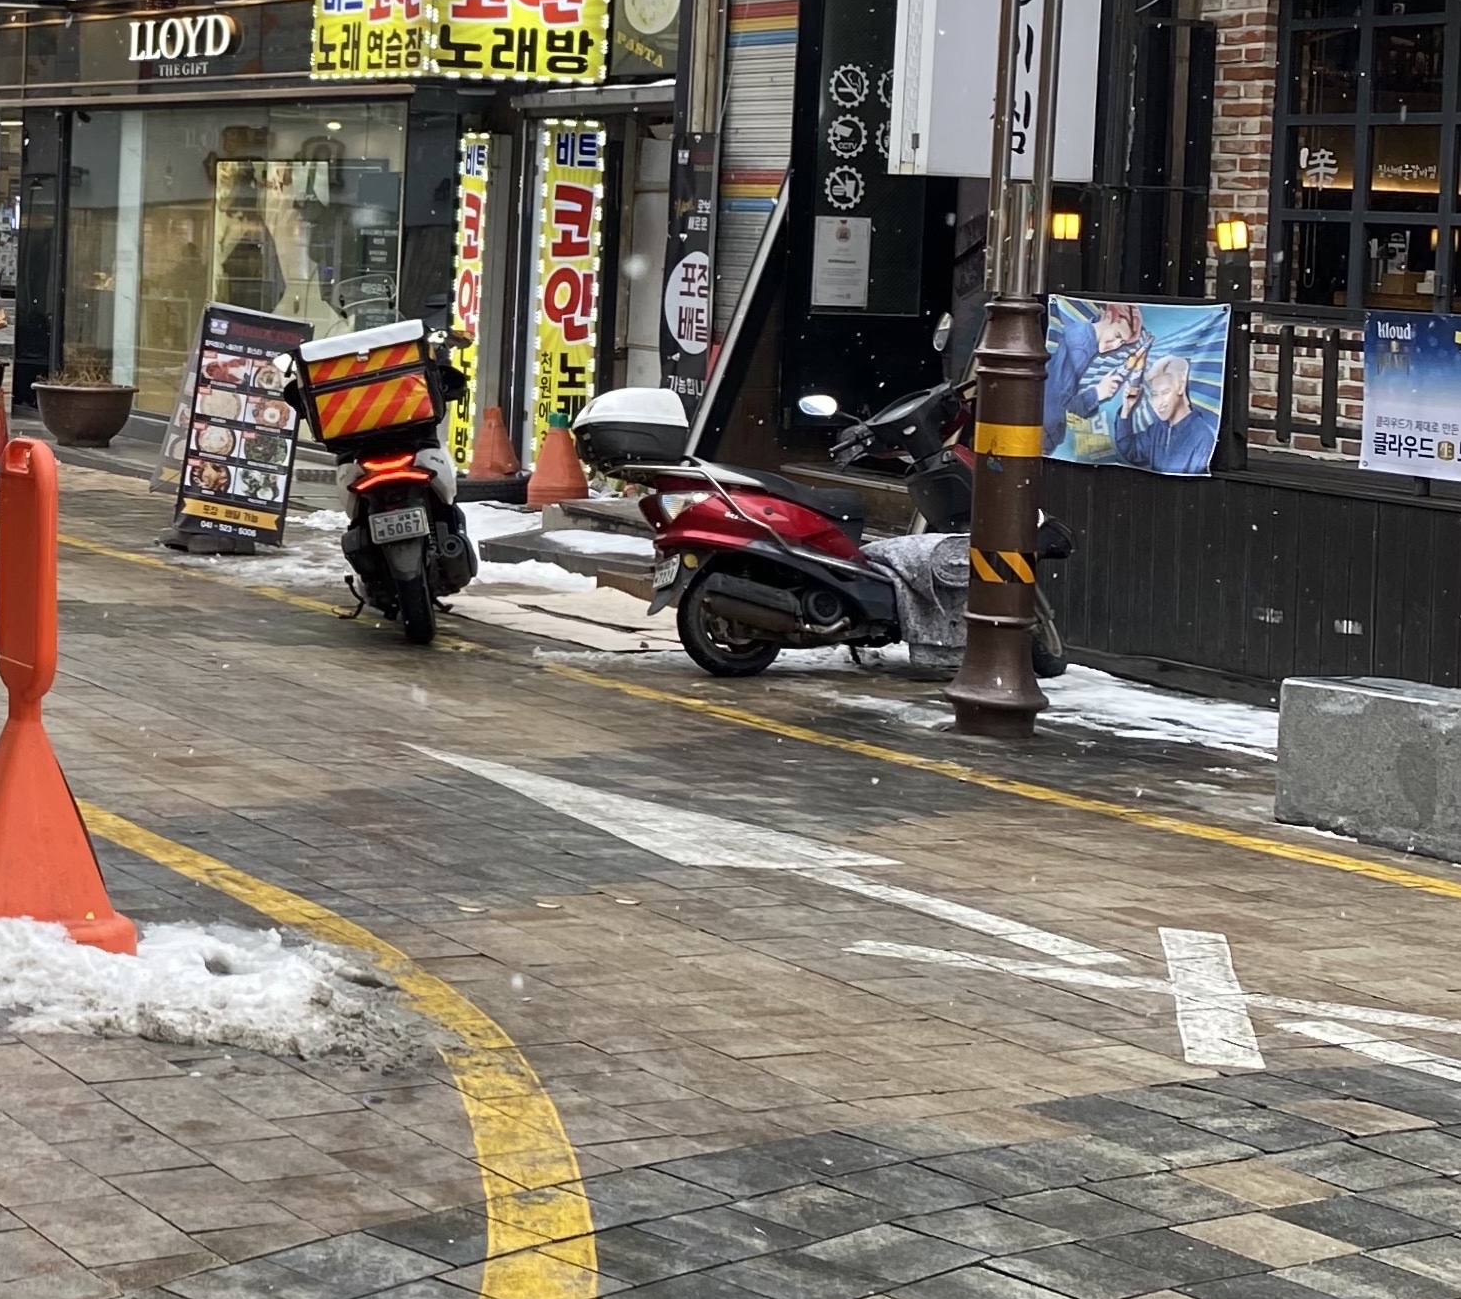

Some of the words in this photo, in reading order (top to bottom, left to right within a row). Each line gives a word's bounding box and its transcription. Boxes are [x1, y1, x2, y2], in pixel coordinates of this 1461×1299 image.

[127, 13, 233, 63] LLOYD
[316, 21, 361, 73] 노래
[366, 26, 424, 71] 연습장
[438, 23, 595, 75] 노래방
[157, 62, 181, 79] THE
[180, 60, 209, 78] GIFT
[465, 143, 486, 176] 비트
[555, 132, 598, 168] 비트
[838, 141, 858, 150] CCTV
[456, 192, 483, 334] 코인
[542, 183, 596, 343] 코인
[1375, 414, 1413, 433] 클라우드가
[1414, 418, 1440, 434] 제대로
[1441, 422, 1460, 437] 만든
[1372, 431, 1435, 460] 클라우드
[387, 519, 421, 537] 5067
